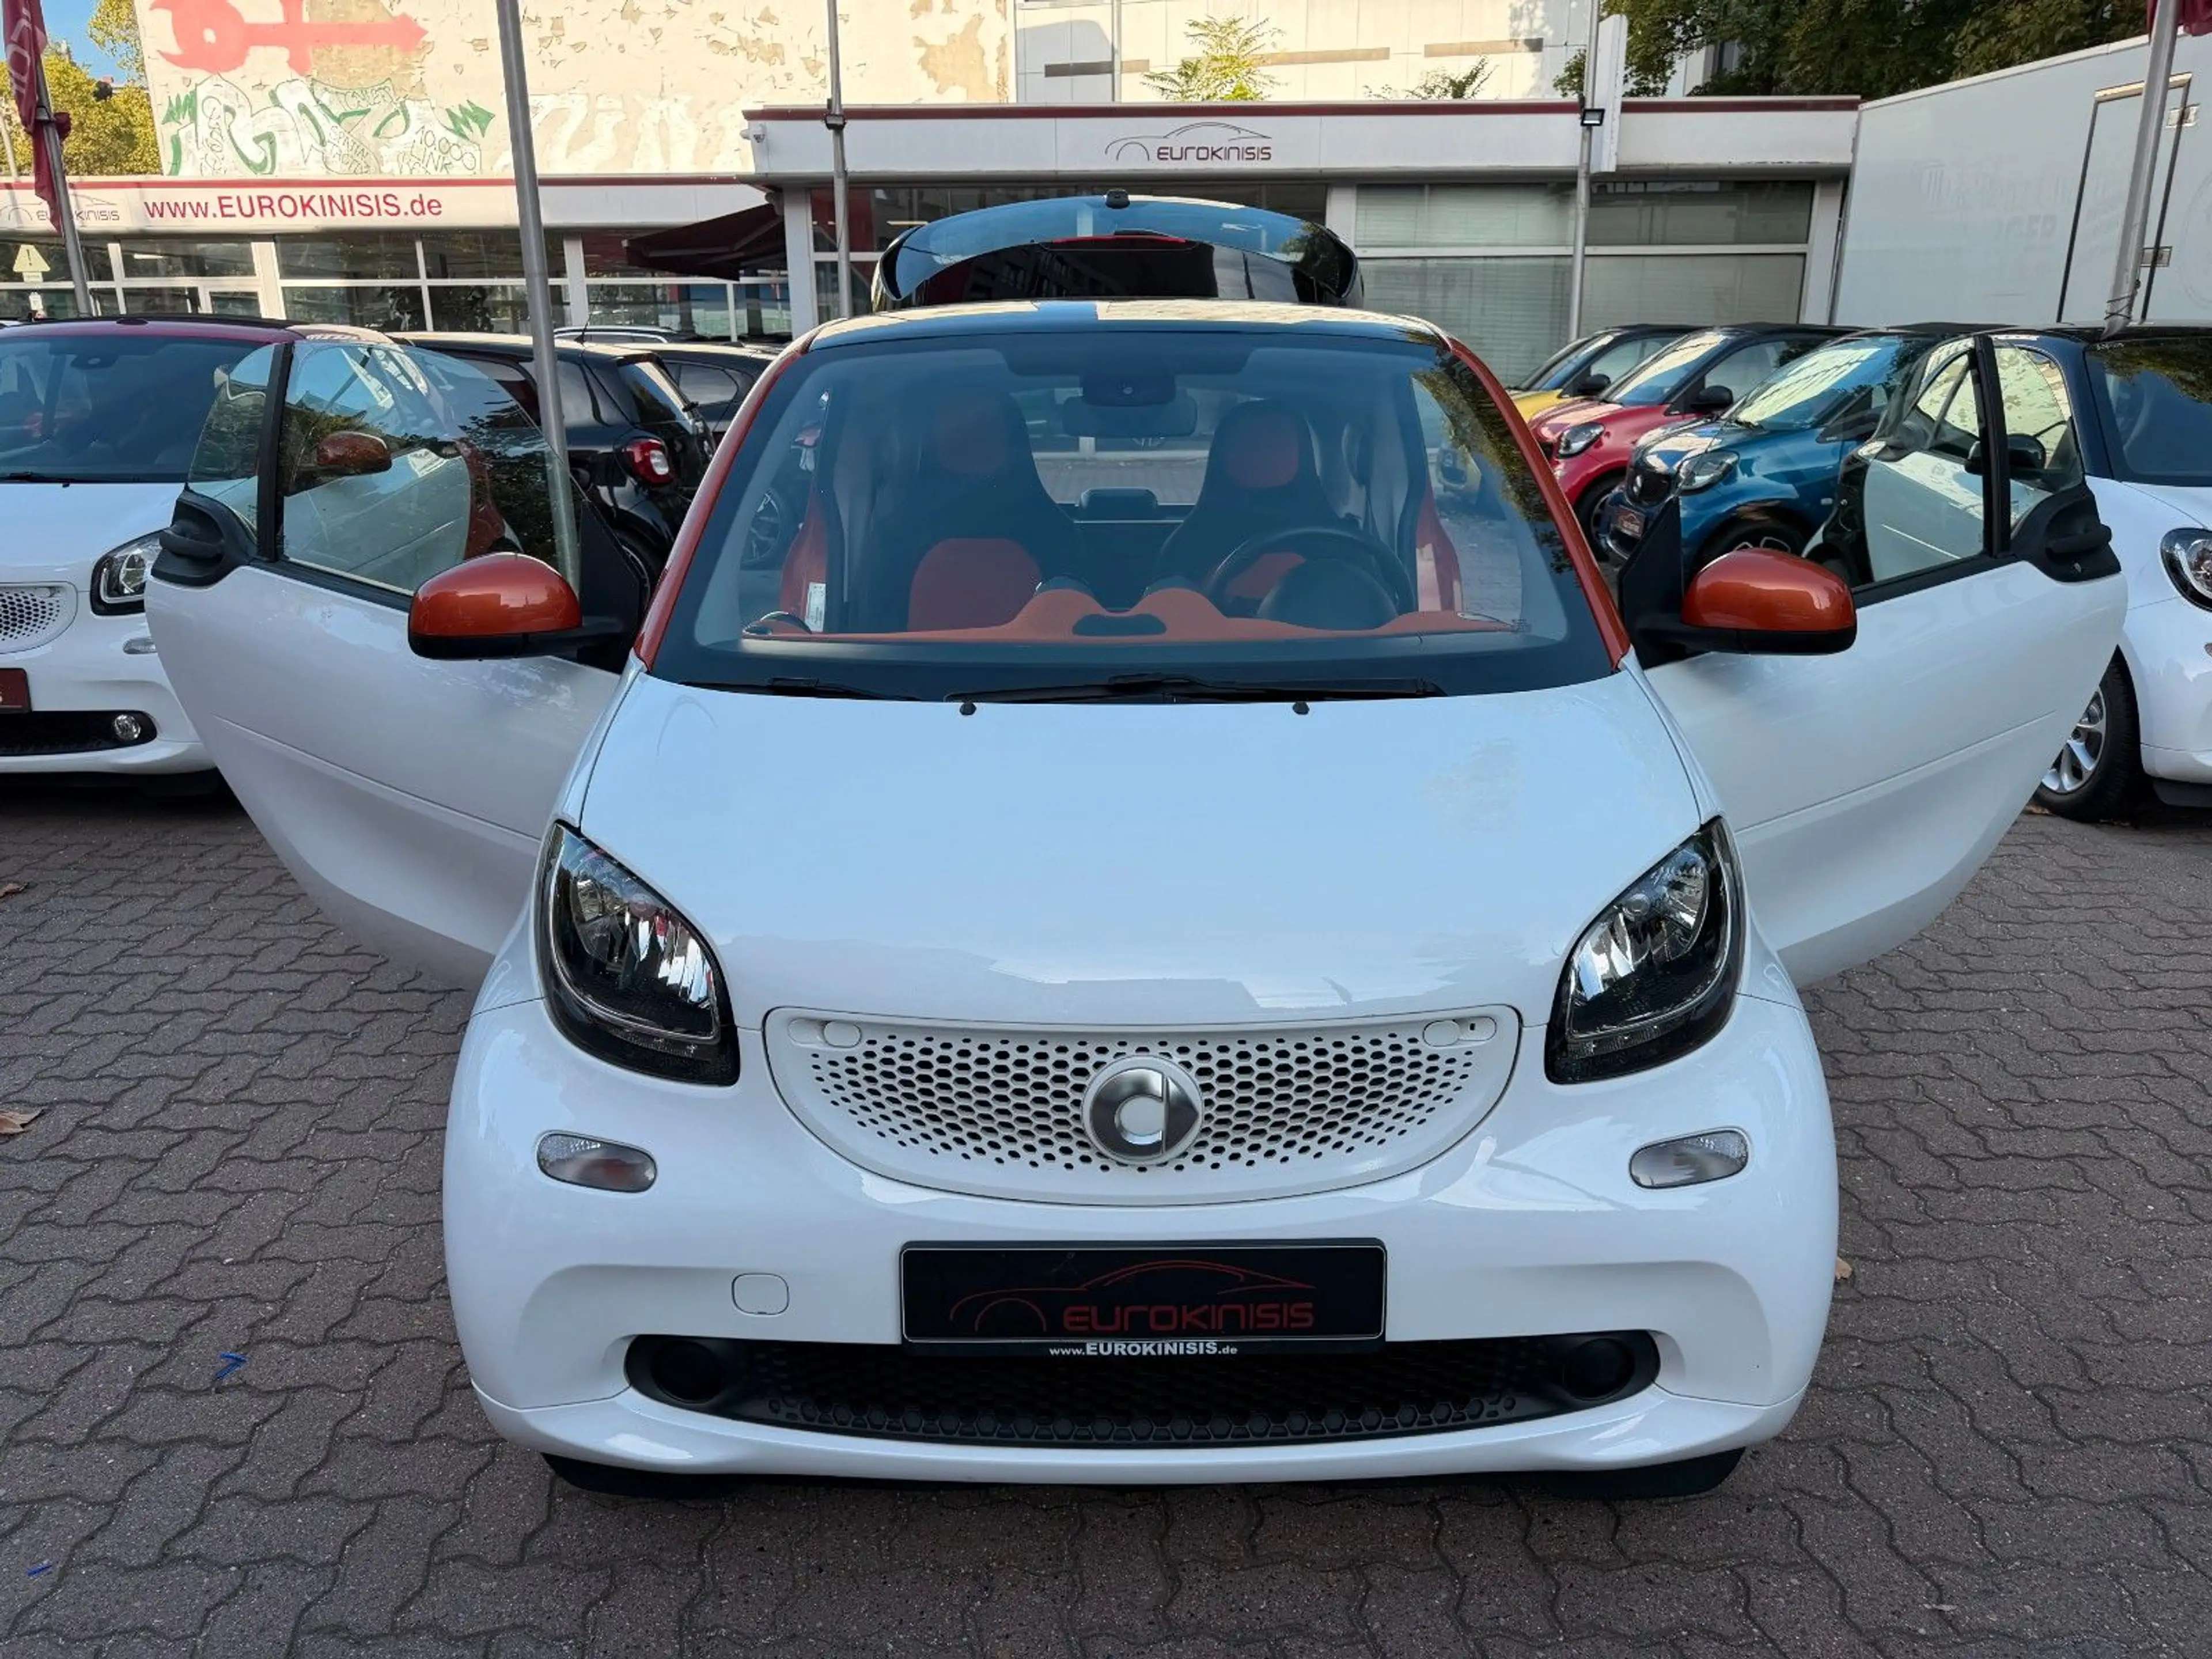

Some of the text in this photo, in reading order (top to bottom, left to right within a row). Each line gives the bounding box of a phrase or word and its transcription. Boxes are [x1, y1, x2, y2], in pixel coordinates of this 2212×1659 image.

[1157, 146, 1272, 161] EUROKINISIS
[144, 194, 442, 218] www.EUROKINISIS.de
[36, 210, 120, 221] EKINISIS
[1063, 1302, 1315, 1332] EUROKINISIS
[1049, 1342, 1238, 1356] www.EUROKINISIS.de
